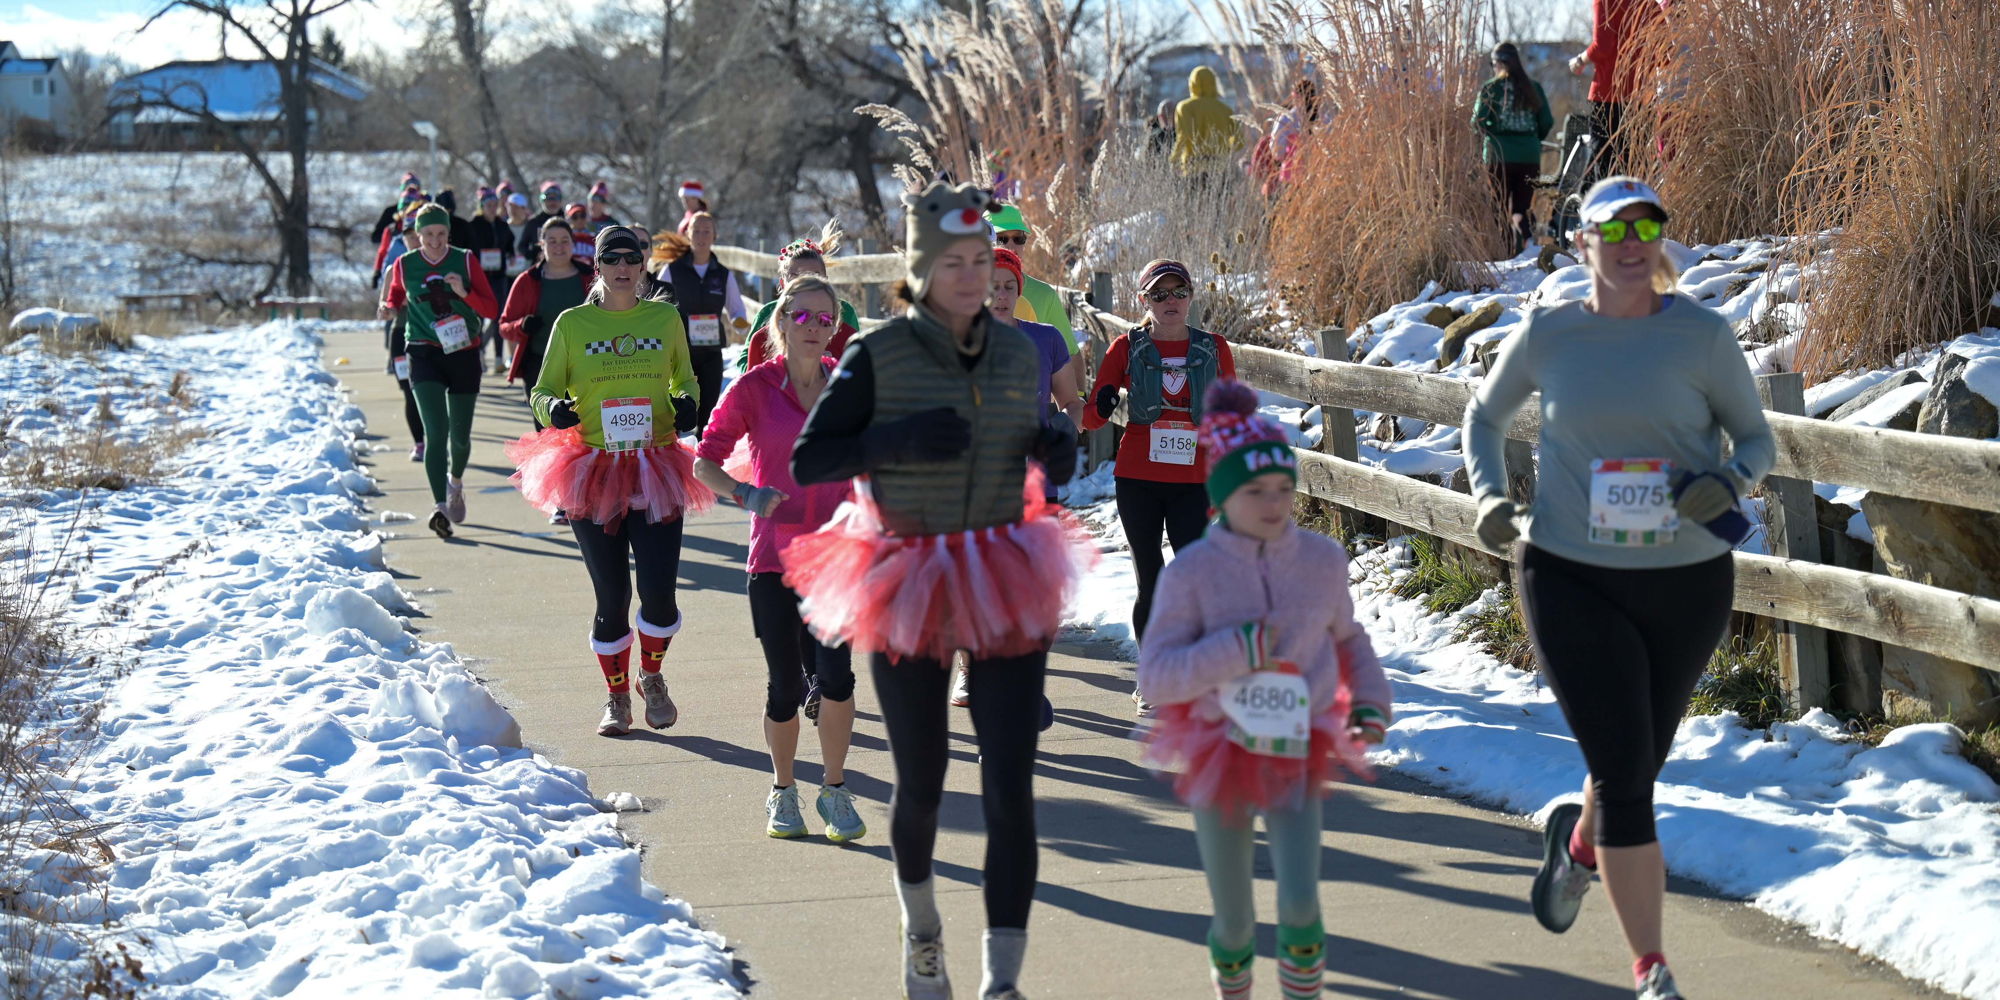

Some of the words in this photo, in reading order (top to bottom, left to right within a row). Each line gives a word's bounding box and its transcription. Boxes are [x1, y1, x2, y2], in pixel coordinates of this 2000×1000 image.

[602, 364, 651, 372] FOUNDATION
[610, 413, 645, 427] 4982
[1159, 436, 1192, 451] 5158
[1607, 484, 1665, 507] 5075
[1234, 685, 1297, 713] 4680
